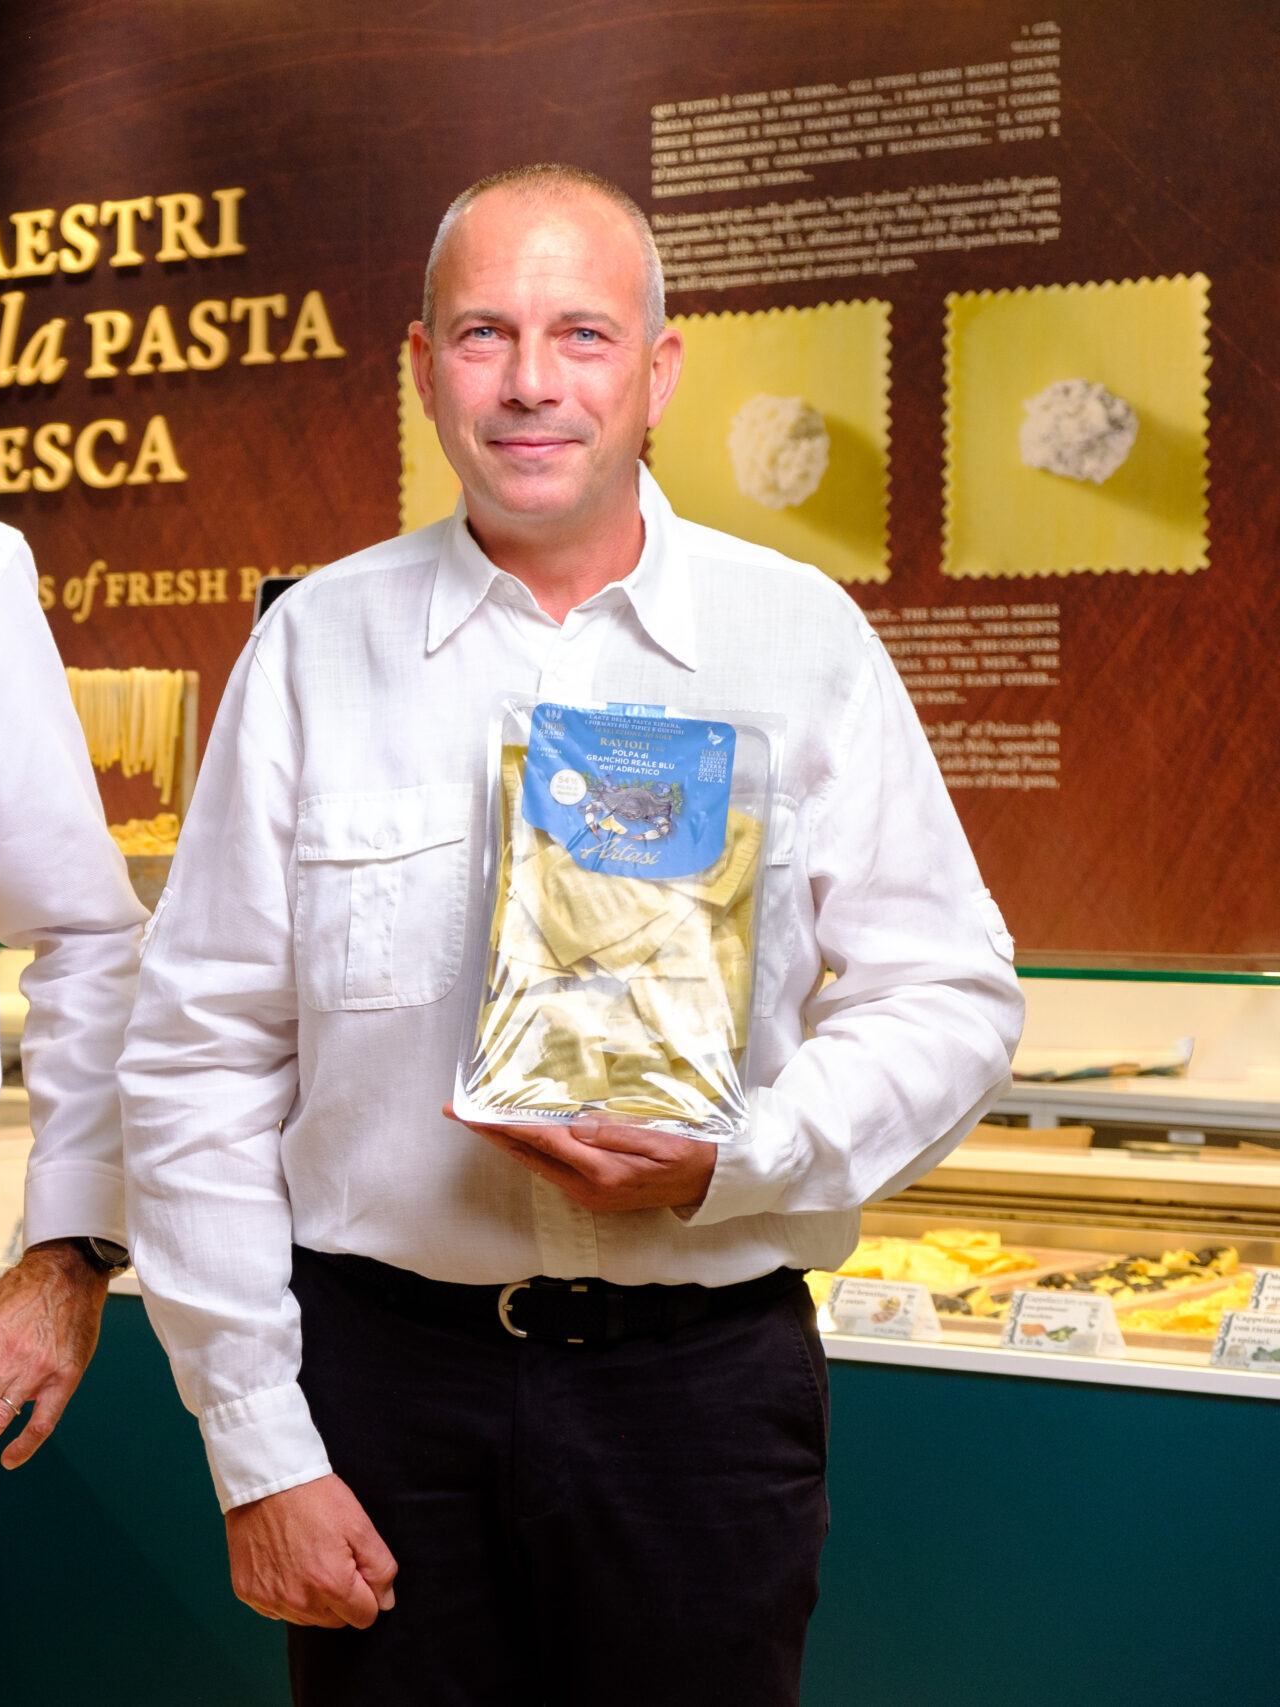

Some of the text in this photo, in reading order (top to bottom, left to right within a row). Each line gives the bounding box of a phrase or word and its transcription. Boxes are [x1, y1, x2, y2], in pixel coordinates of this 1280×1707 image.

[85, 290, 345, 379] PASTA
[63, 559, 107, 624] of
[104, 568, 228, 608] FRESH
[600, 737, 650, 751] RAVIOLI
[586, 754, 675, 770] GRANCHIO REALE BLU
[612, 749, 649, 760] POLPA di
